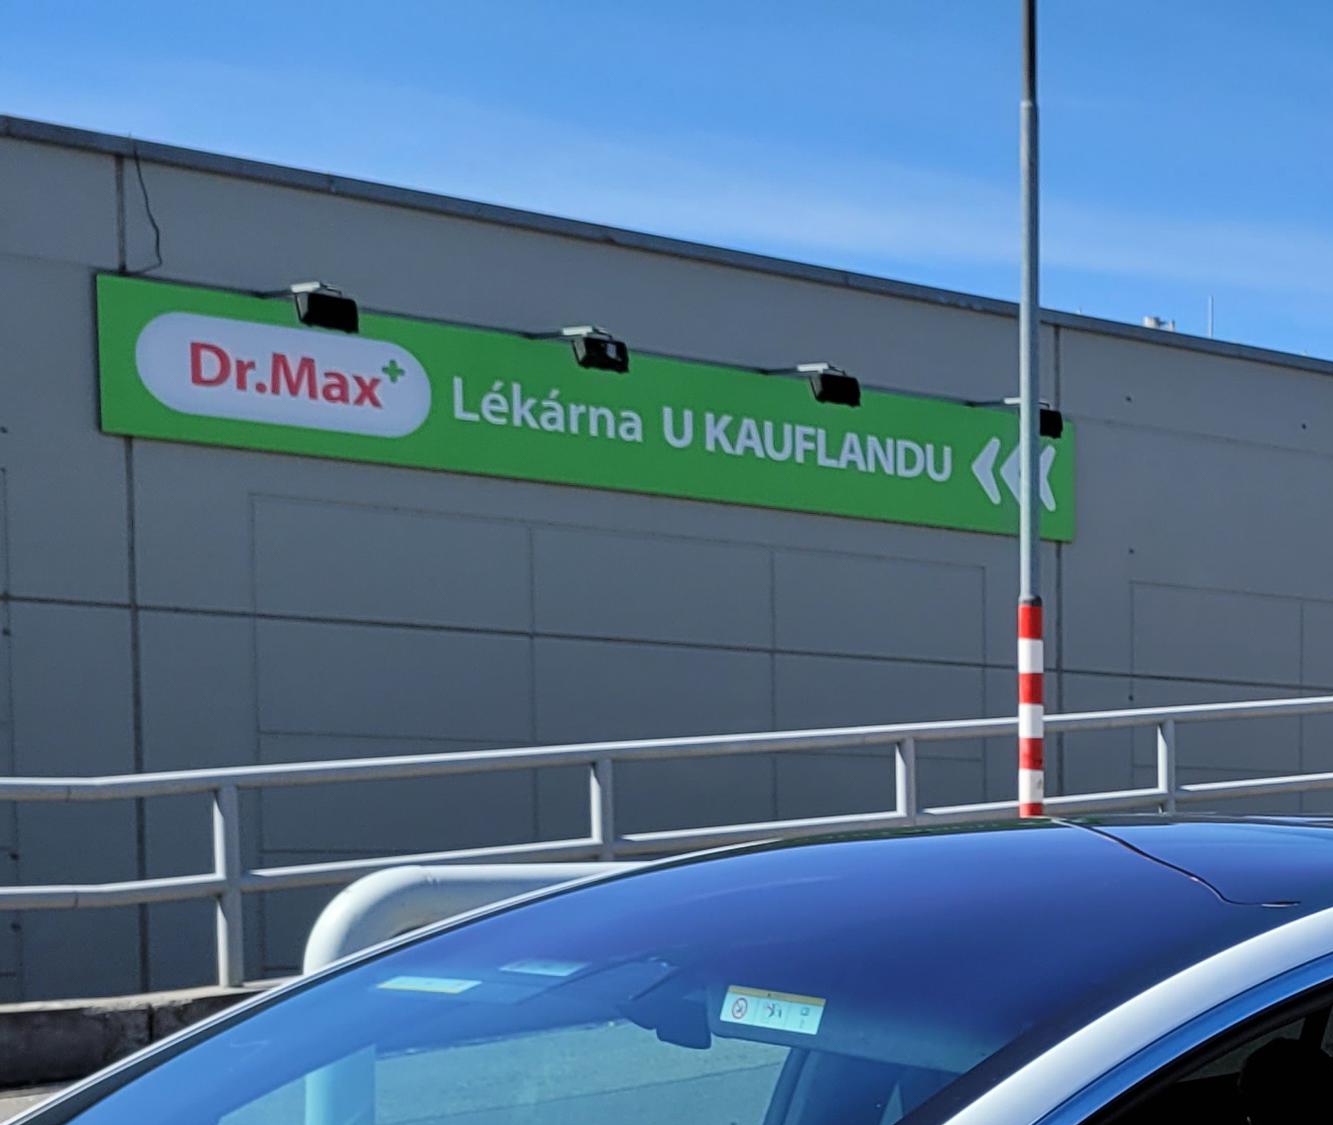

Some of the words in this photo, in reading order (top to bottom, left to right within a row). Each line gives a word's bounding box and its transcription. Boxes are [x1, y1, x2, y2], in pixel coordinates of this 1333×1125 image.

[452, 375, 643, 443] Lékárna
[662, 406, 693, 448] U
[705, 412, 952, 482] KAUFLANDU
